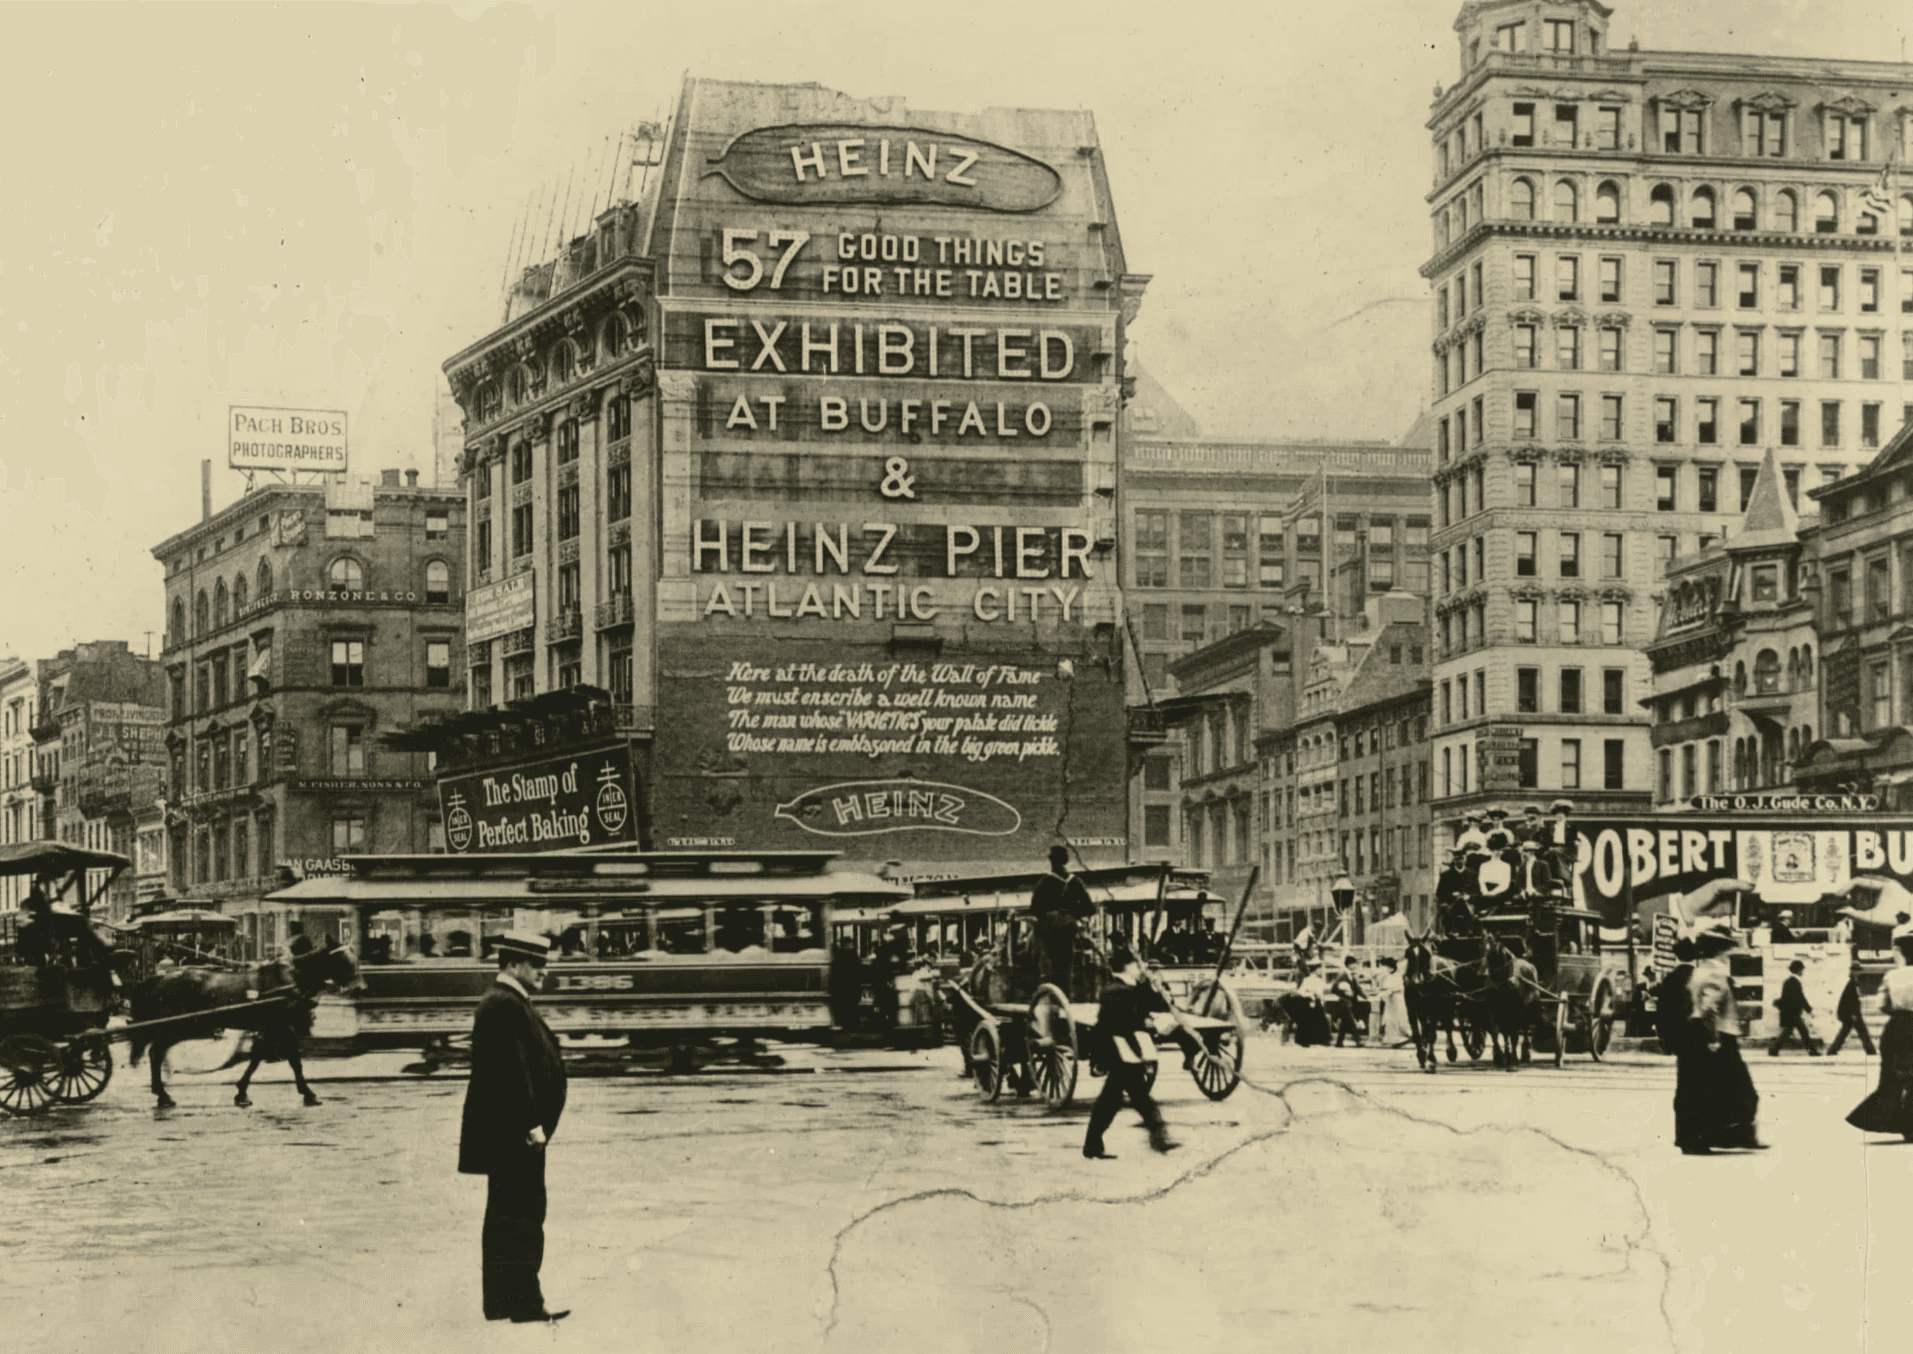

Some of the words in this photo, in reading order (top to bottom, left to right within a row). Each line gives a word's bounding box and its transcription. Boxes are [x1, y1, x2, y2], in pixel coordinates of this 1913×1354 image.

[791, 138, 979, 187] HEINZ
[722, 228, 810, 291] 57
[838, 232, 920, 263] GOOD
[934, 236, 1045, 267] THINGS
[823, 266, 882, 295] FOR
[894, 267, 952, 297] THE
[966, 270, 1062, 300] TABLE
[704, 317, 1075, 380] EXHIBITED
[234, 413, 282, 433] PACH
[290, 416, 345, 436] BROS.
[725, 395, 786, 431] AT
[820, 396, 1052, 437] BUFFALO
[232, 441, 344, 461] PHOTOGRAPHERS
[880, 457, 915, 498] &
[693, 520, 899, 575] HEINZ
[946, 524, 1094, 580] PIER
[704, 581, 938, 621] ATLANTIC
[973, 587, 1079, 621] CITY
[725, 661, 770, 682] Here
[775, 663, 795, 682] at
[799, 663, 826, 682] the
[828, 663, 875, 682] death
[876, 664, 900, 690] of
[900, 664, 927, 684] the
[931, 664, 975, 684] Wall
[976, 665, 998, 690] of
[996, 665, 1041, 684] Fame
[726, 686, 752, 704] We
[754, 687, 800, 705] must
[801, 686, 873, 706] enscribe
[877, 693, 891, 707] a
[893, 688, 934, 708] well
[934, 688, 987, 708] known
[990, 694, 1038, 709] name
[728, 708, 760, 728] The
[762, 714, 797, 729] man
[800, 709, 842, 730] whose
[920, 717, 953, 737] your
[952, 712, 998, 737] palate
[998, 714, 1024, 732] did
[1023, 713, 1059, 732] tickle
[726, 732, 776, 752] Whose
[776, 738, 816, 752] name
[815, 733, 828, 752] is
[829, 733, 916, 758] emblazoned
[915, 735, 931, 753] in
[933, 735, 959, 754] the
[961, 736, 984, 762] big
[979, 741, 1019, 762] green
[482, 777, 511, 807] The
[512, 773, 558, 806] Stamp
[562, 762, 578, 794] of
[831, 790, 965, 825] HEINZ
[1700, 796, 1729, 809] The
[1770, 796, 1810, 809] Gude
[477, 816, 529, 848] Perfect
[530, 805, 590, 845] Baking
